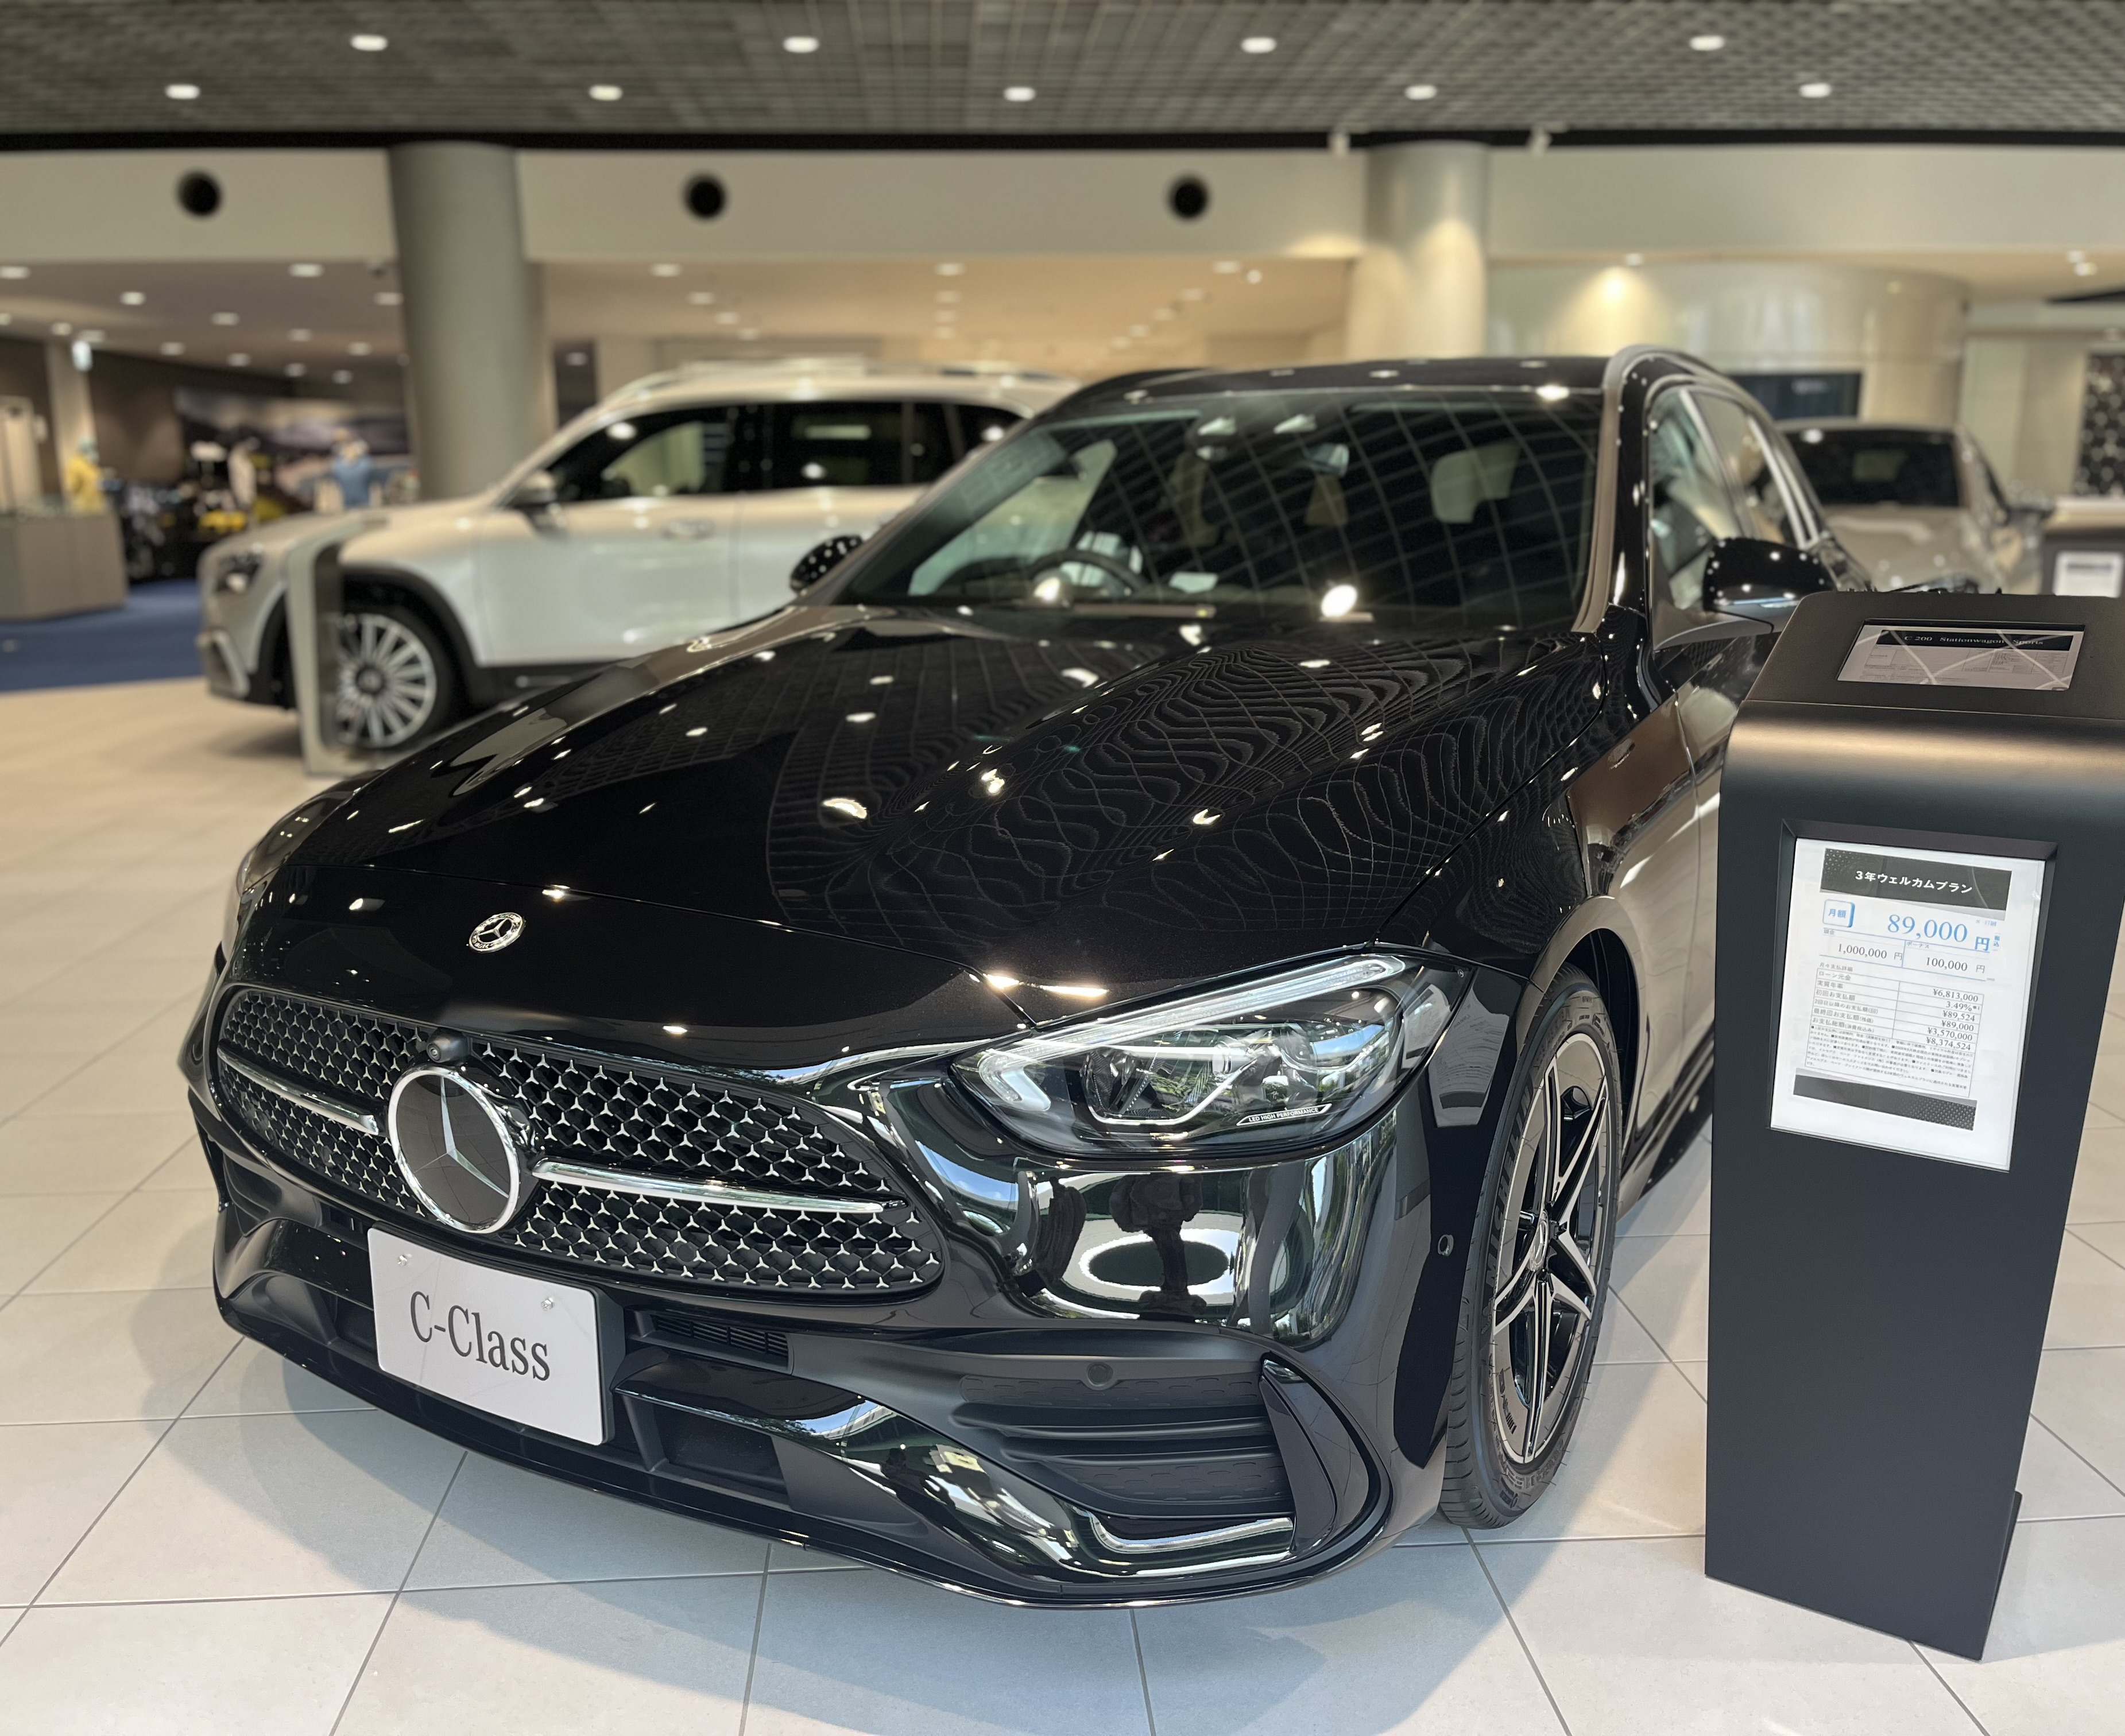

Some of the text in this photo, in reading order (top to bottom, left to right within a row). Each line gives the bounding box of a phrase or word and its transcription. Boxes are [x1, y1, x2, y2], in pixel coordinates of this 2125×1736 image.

[1855, 870, 1973, 894] 3年ウェルカムプラン
[1828, 909, 1847, 919] 月額
[1887, 914, 1990, 951] 89,000 円
[1838, 943, 1903, 960] 1,000,000 円
[1926, 957, 1985, 974] 100,000 円
[1933, 989, 1979, 1002] ¥6,813,000
[1943, 1010, 1975, 1022] ¥89,524
[1941, 1020, 1974, 1032] ¥89,000
[1927, 1027, 1973, 1041] ¥3,570,000
[1926, 1037, 1971, 1051] ¥8,374,524
[1276, 1107, 1319, 1118] PERFORMANCE
[1485, 1083, 1531, 1288] MICHELIN
[410, 1291, 551, 1382] C-Class
